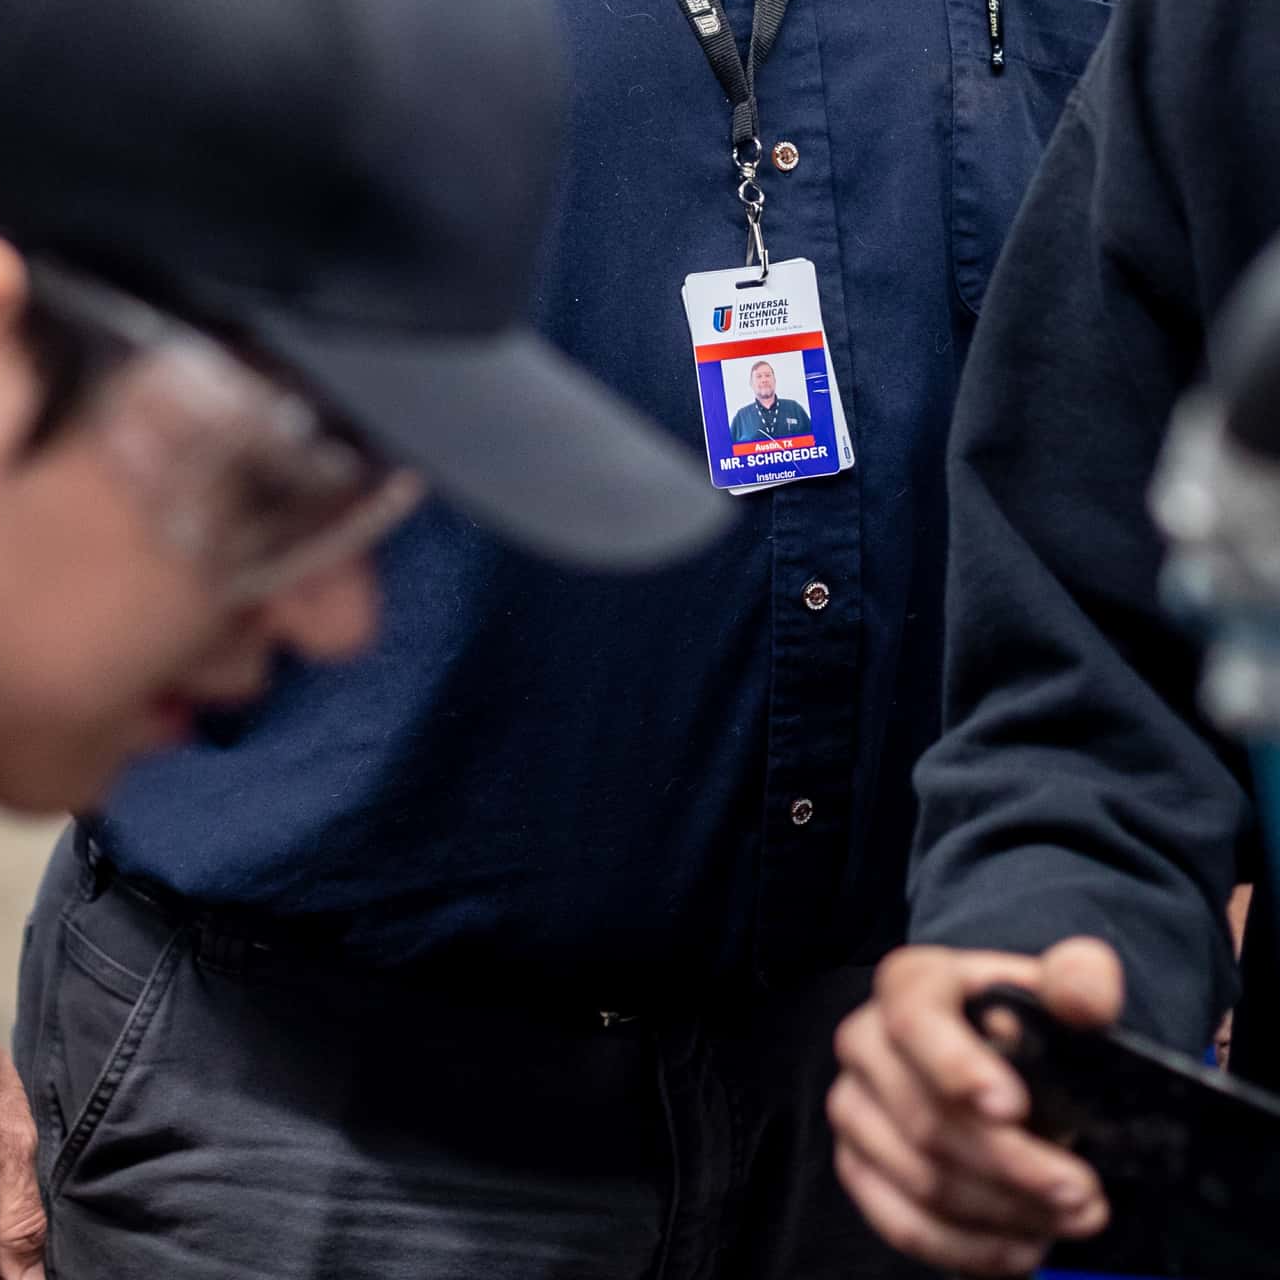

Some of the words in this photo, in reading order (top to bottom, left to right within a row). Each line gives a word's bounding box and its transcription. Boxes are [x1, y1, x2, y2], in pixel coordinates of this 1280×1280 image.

[739, 298, 789, 311] UNIVERSAL
[739, 307, 788, 320] TECHNICAL
[739, 316, 788, 328] INSTITUTE
[782, 439, 793, 448] TX
[720, 457, 745, 470] MR.
[747, 446, 828, 467] SCHROEDER
[756, 469, 797, 482] Instructor
